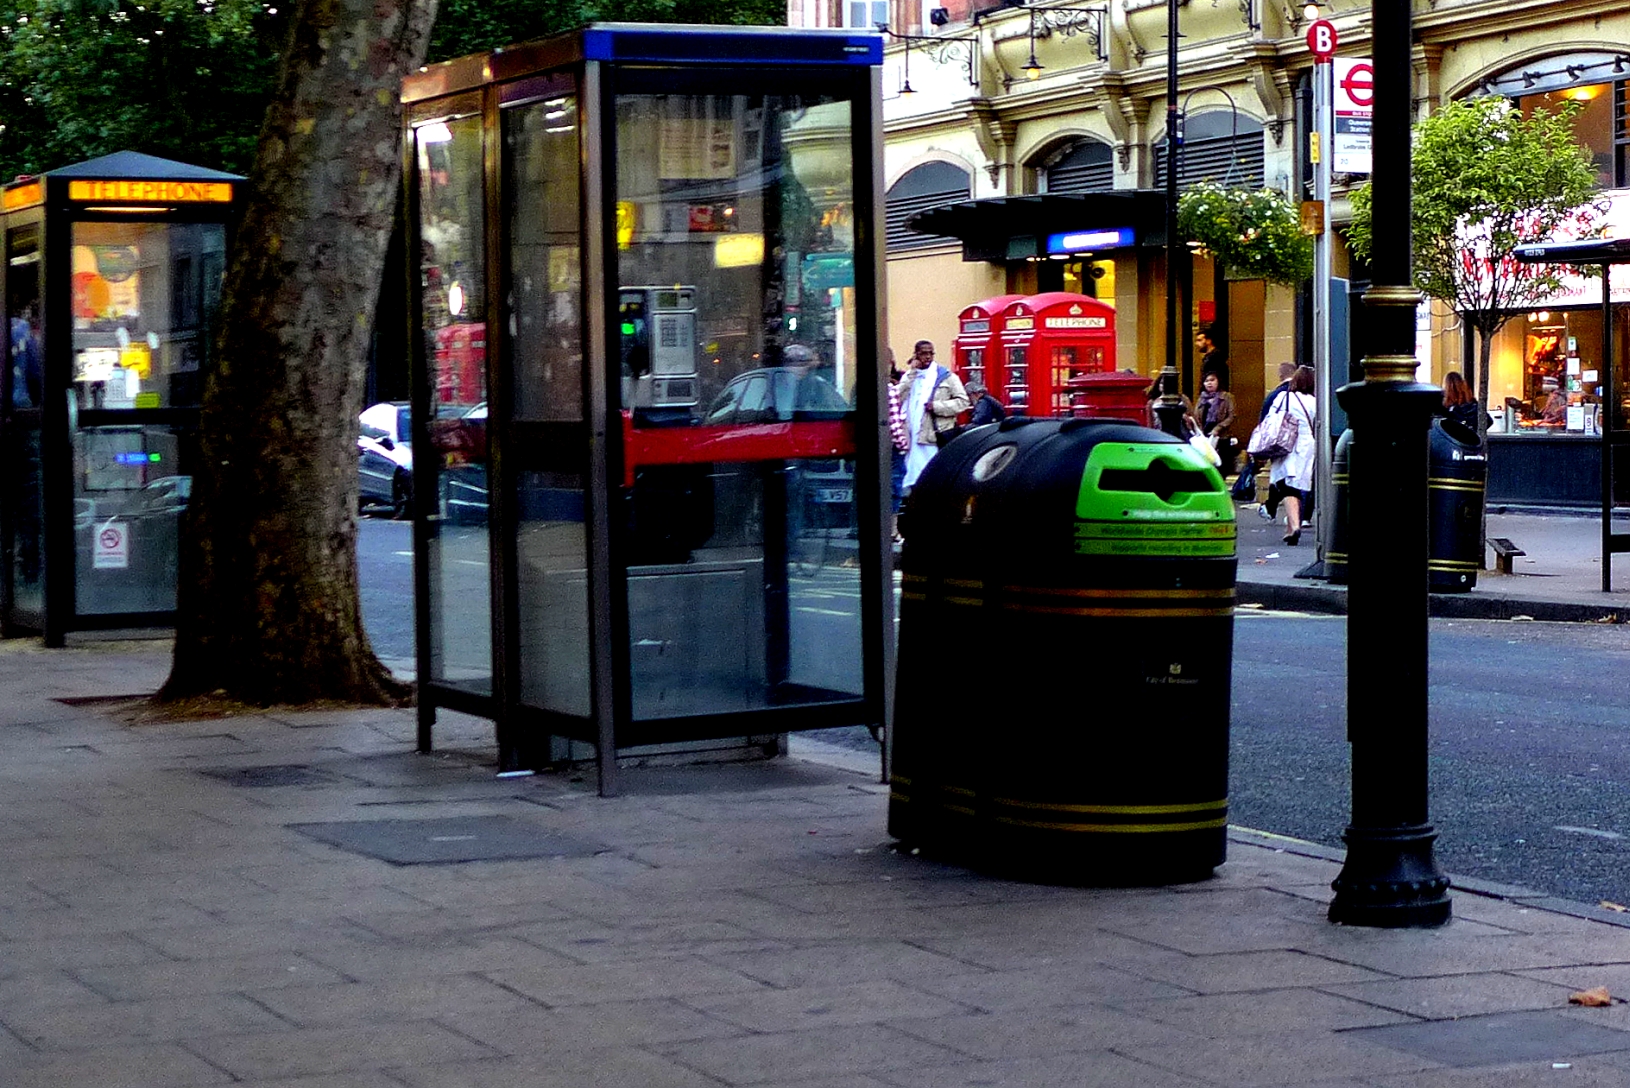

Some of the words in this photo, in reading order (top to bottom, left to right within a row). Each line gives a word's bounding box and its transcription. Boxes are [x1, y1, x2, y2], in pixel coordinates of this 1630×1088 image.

[1316, 25, 1333, 53] B
[86, 181, 213, 201] TELEPHONE
[1048, 318, 1102, 327] TELEPHONE
